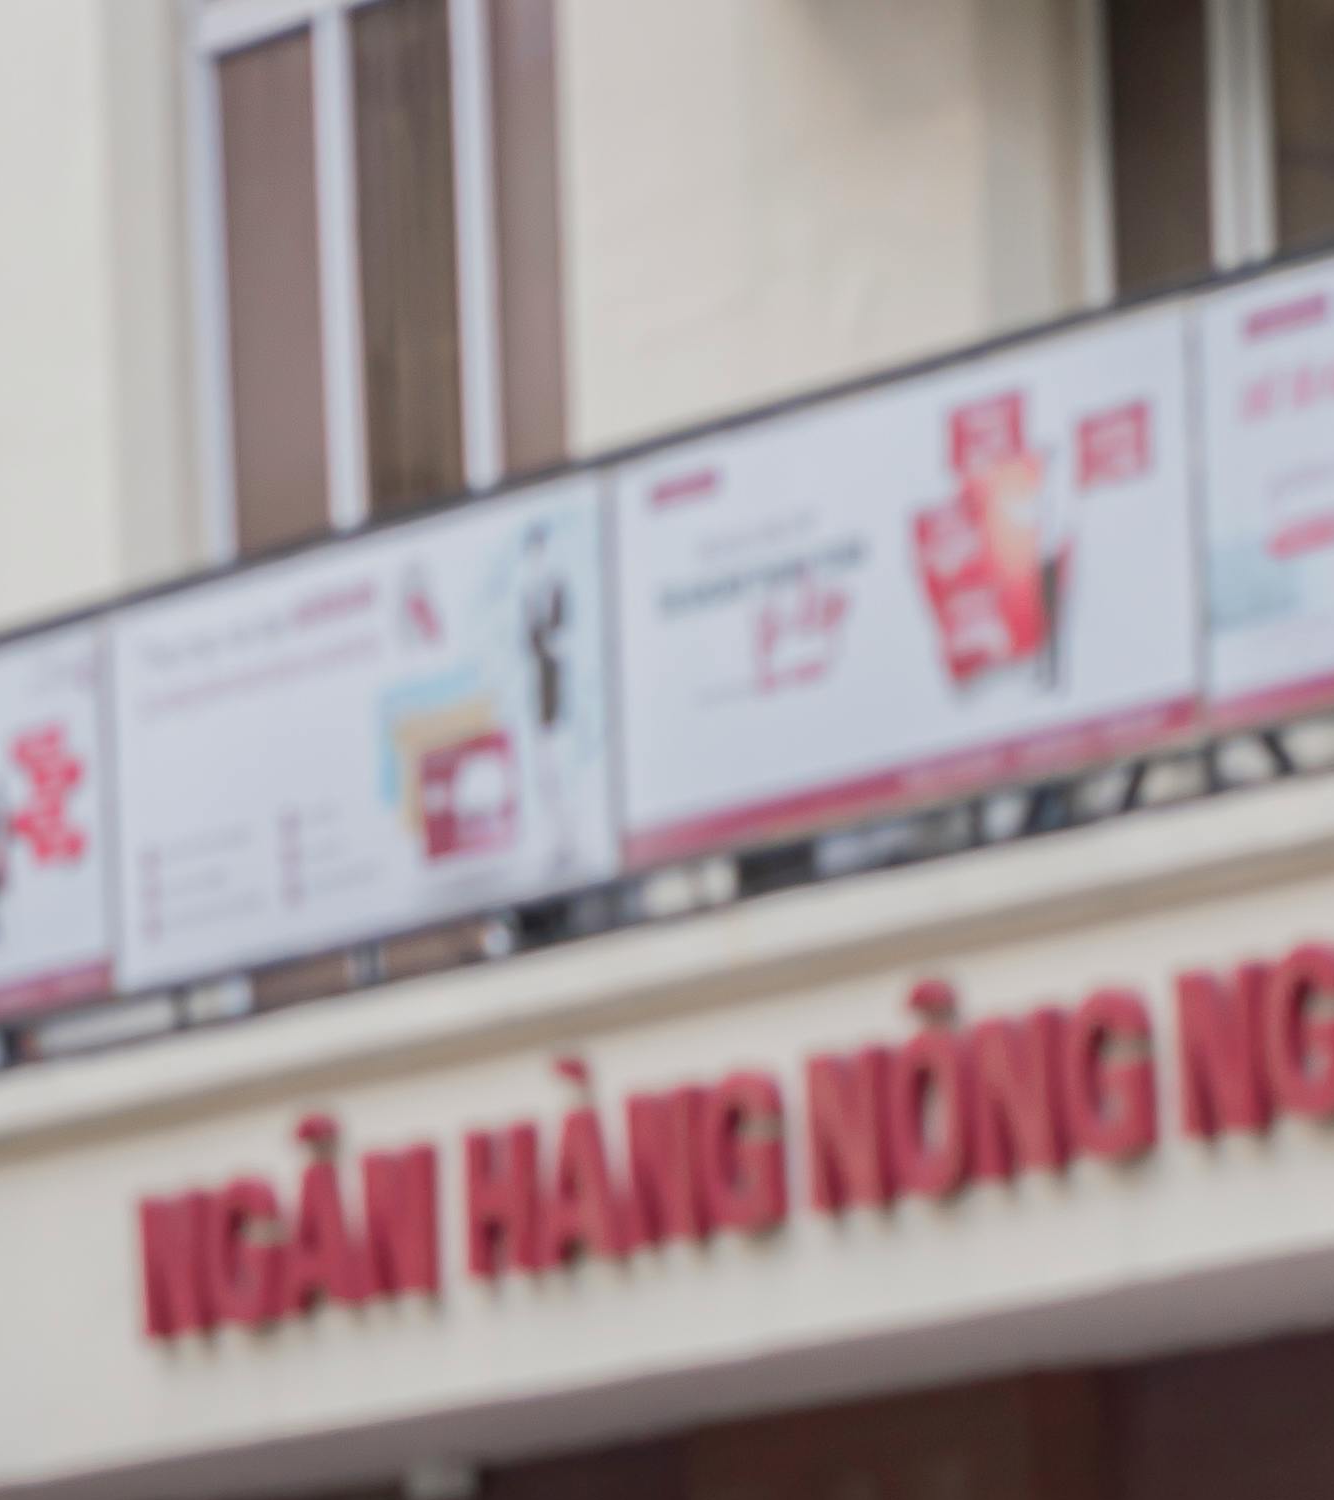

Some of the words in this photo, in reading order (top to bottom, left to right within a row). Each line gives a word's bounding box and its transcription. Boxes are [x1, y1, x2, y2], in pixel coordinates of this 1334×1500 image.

[140, 1114, 442, 1338] NGÂN
[463, 1056, 789, 1280] HÀNG
[805, 980, 1161, 1214] NÔNG
